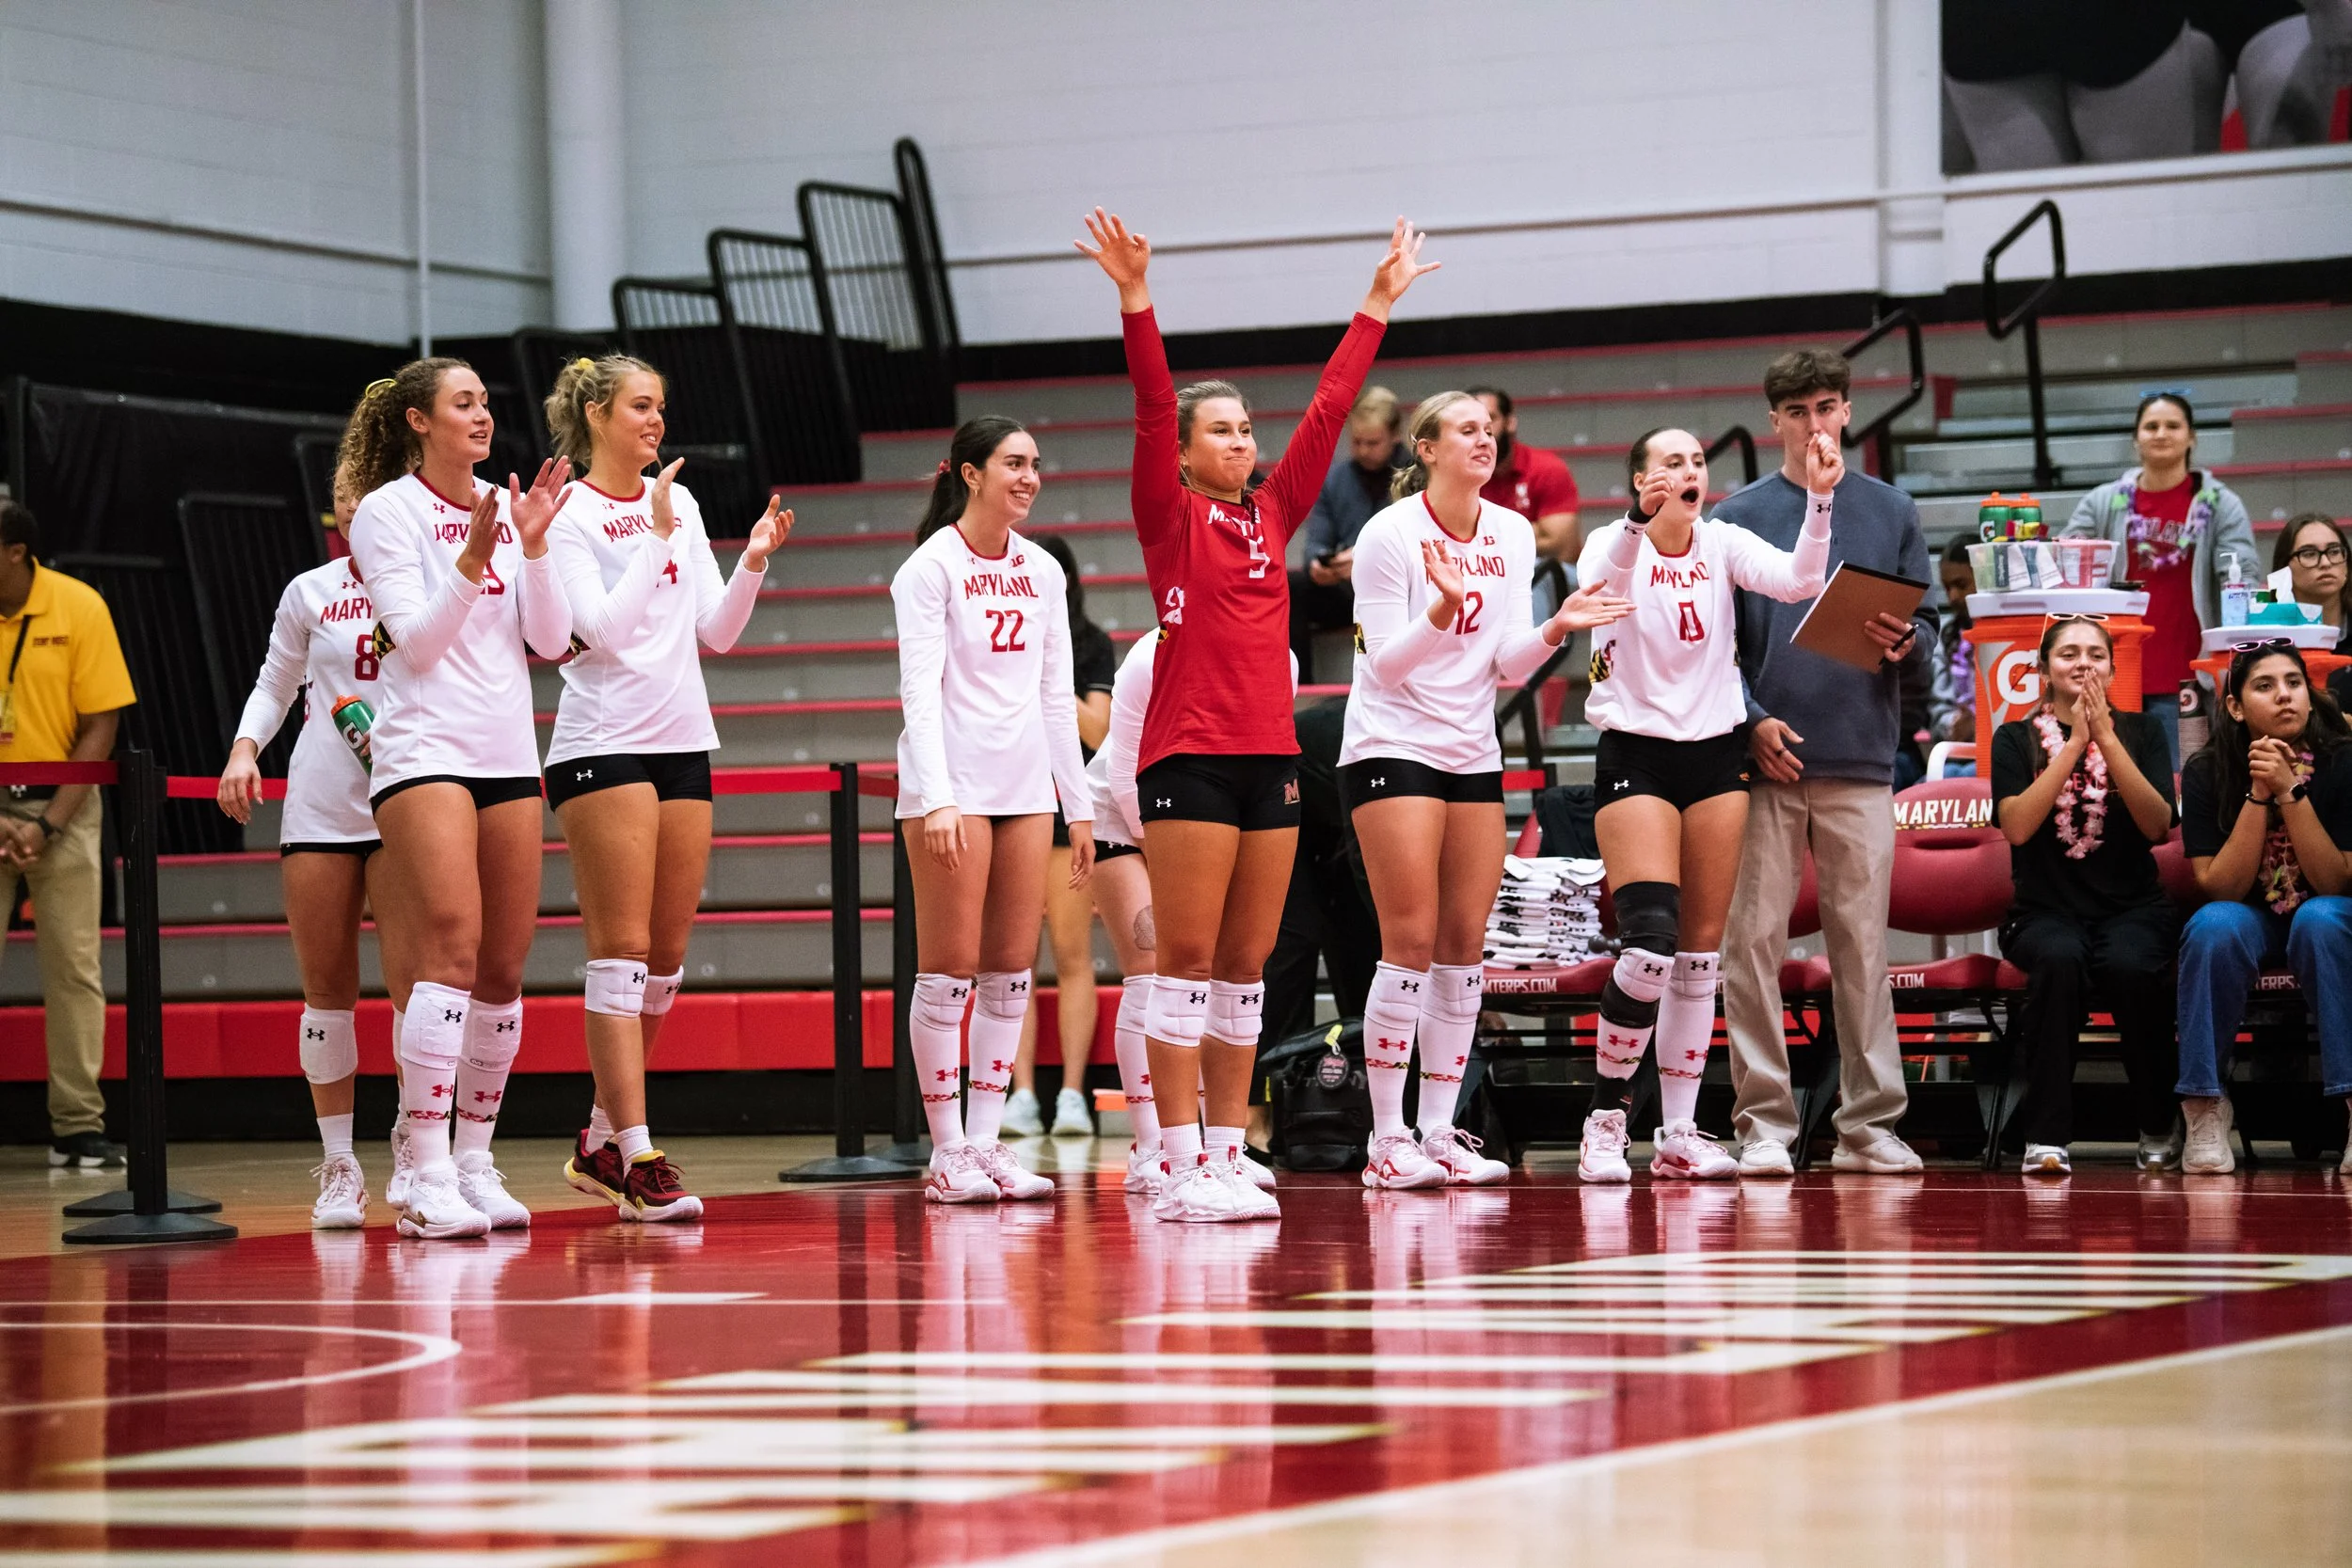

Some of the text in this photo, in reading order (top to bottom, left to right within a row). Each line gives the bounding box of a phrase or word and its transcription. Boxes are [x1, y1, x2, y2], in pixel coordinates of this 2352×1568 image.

[1248, 535, 1270, 578] 5
[985, 610, 1025, 652] 22
[1454, 591, 1483, 635] 12
[354, 634, 379, 681] 8
[1996, 649, 2040, 705] G
[342, 722, 365, 750] G
[1894, 799, 1993, 825] MARYLAN
